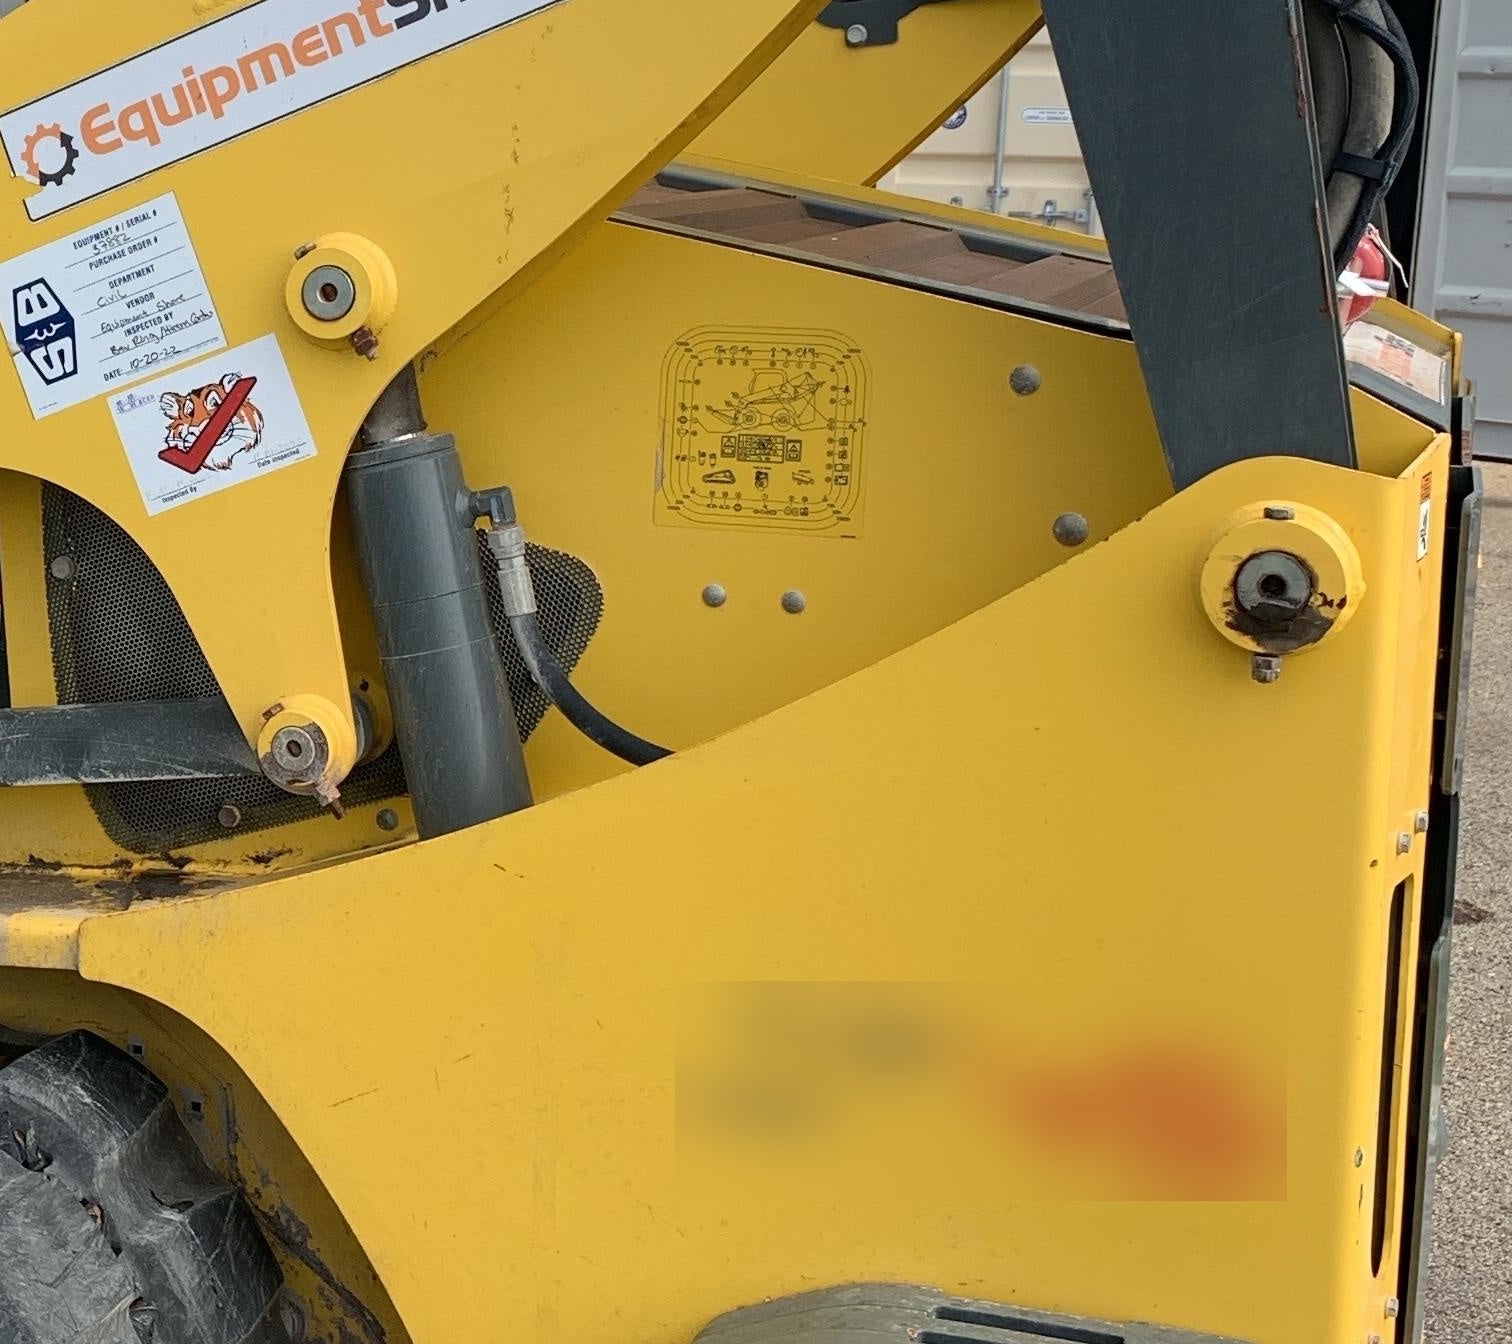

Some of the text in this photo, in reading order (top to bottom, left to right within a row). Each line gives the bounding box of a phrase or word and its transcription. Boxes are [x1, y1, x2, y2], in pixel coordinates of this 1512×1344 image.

[72, 226, 114, 251] EQUIPMENT
[126, 212, 152, 229] SERIAL
[88, 249, 127, 271] PURCHASE
[128, 238, 153, 255] ORDER
[108, 265, 156, 290] DEPARTMENT
[125, 292, 155, 309] VENDOR
[123, 311, 174, 337] INSPECTED BY
[103, 367, 124, 382] DATE:
